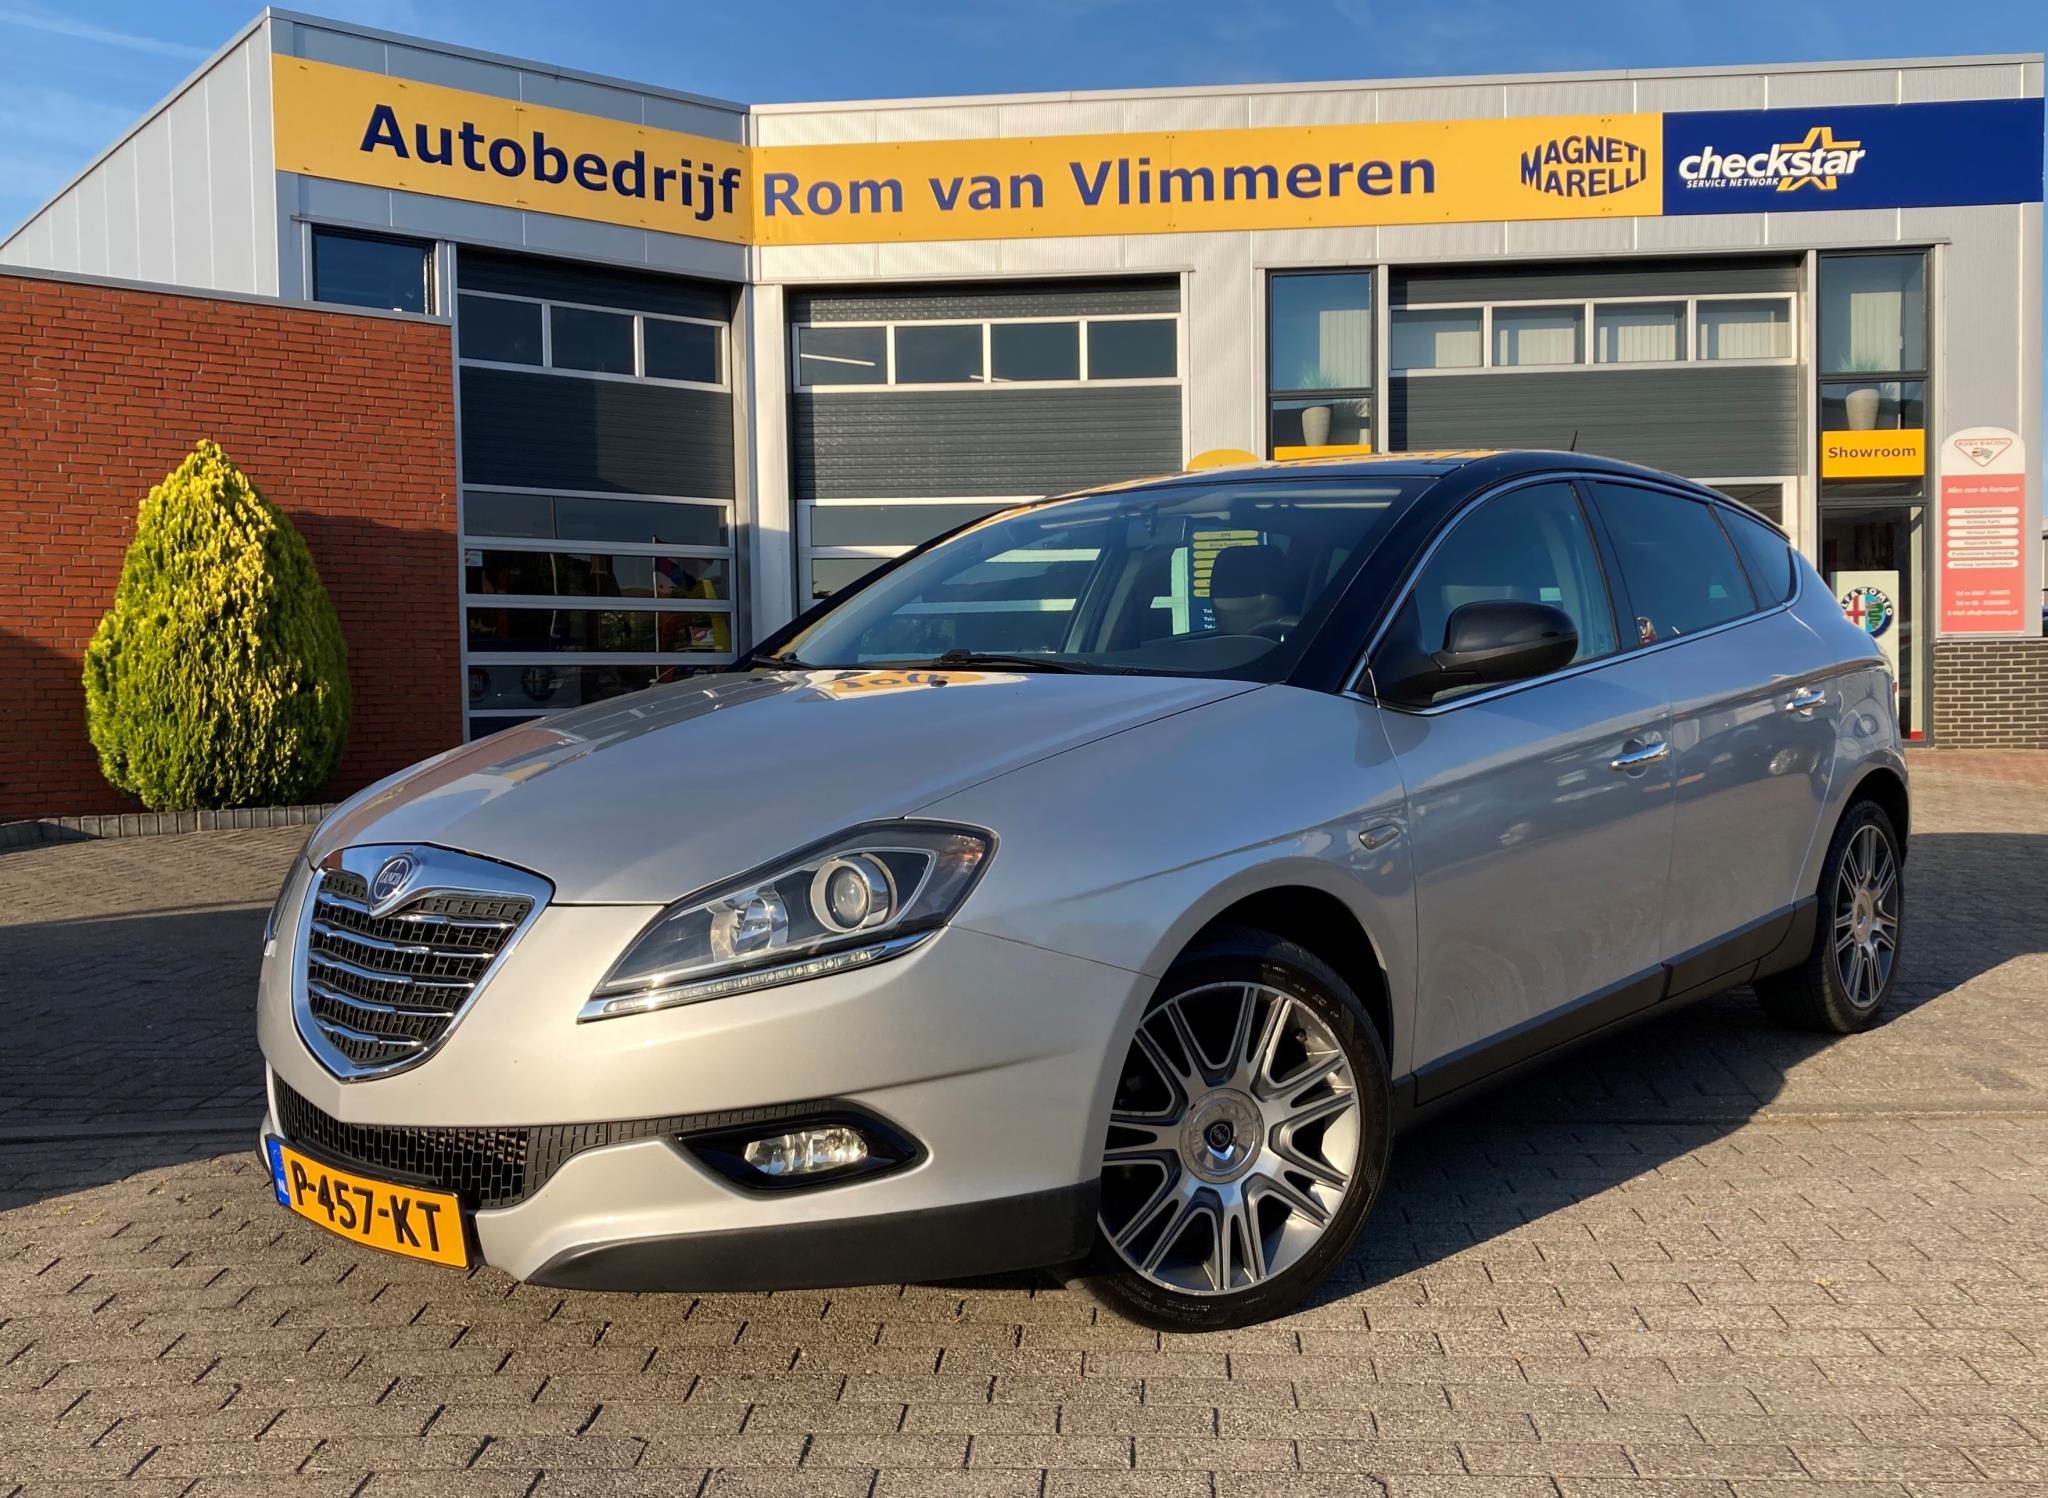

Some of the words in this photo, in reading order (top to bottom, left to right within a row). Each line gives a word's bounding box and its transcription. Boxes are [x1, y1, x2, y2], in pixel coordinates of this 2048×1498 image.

[360, 103, 741, 221] Autobedrijf
[763, 170, 902, 217] Rom
[928, 172, 1044, 212] van
[1069, 156, 1436, 207] Vlimmeren
[1521, 135, 1647, 192] MAGNETI
[1521, 144, 1647, 197] MARELLI
[1678, 143, 1866, 180] checkstar
[1686, 177, 1727, 189] SERVICE
[1729, 176, 1780, 188] NETWORK
[1828, 446, 1917, 459] Showroom
[1861, 587, 1893, 616] ROMEO
[290, 1159, 441, 1252] P-457-KT
